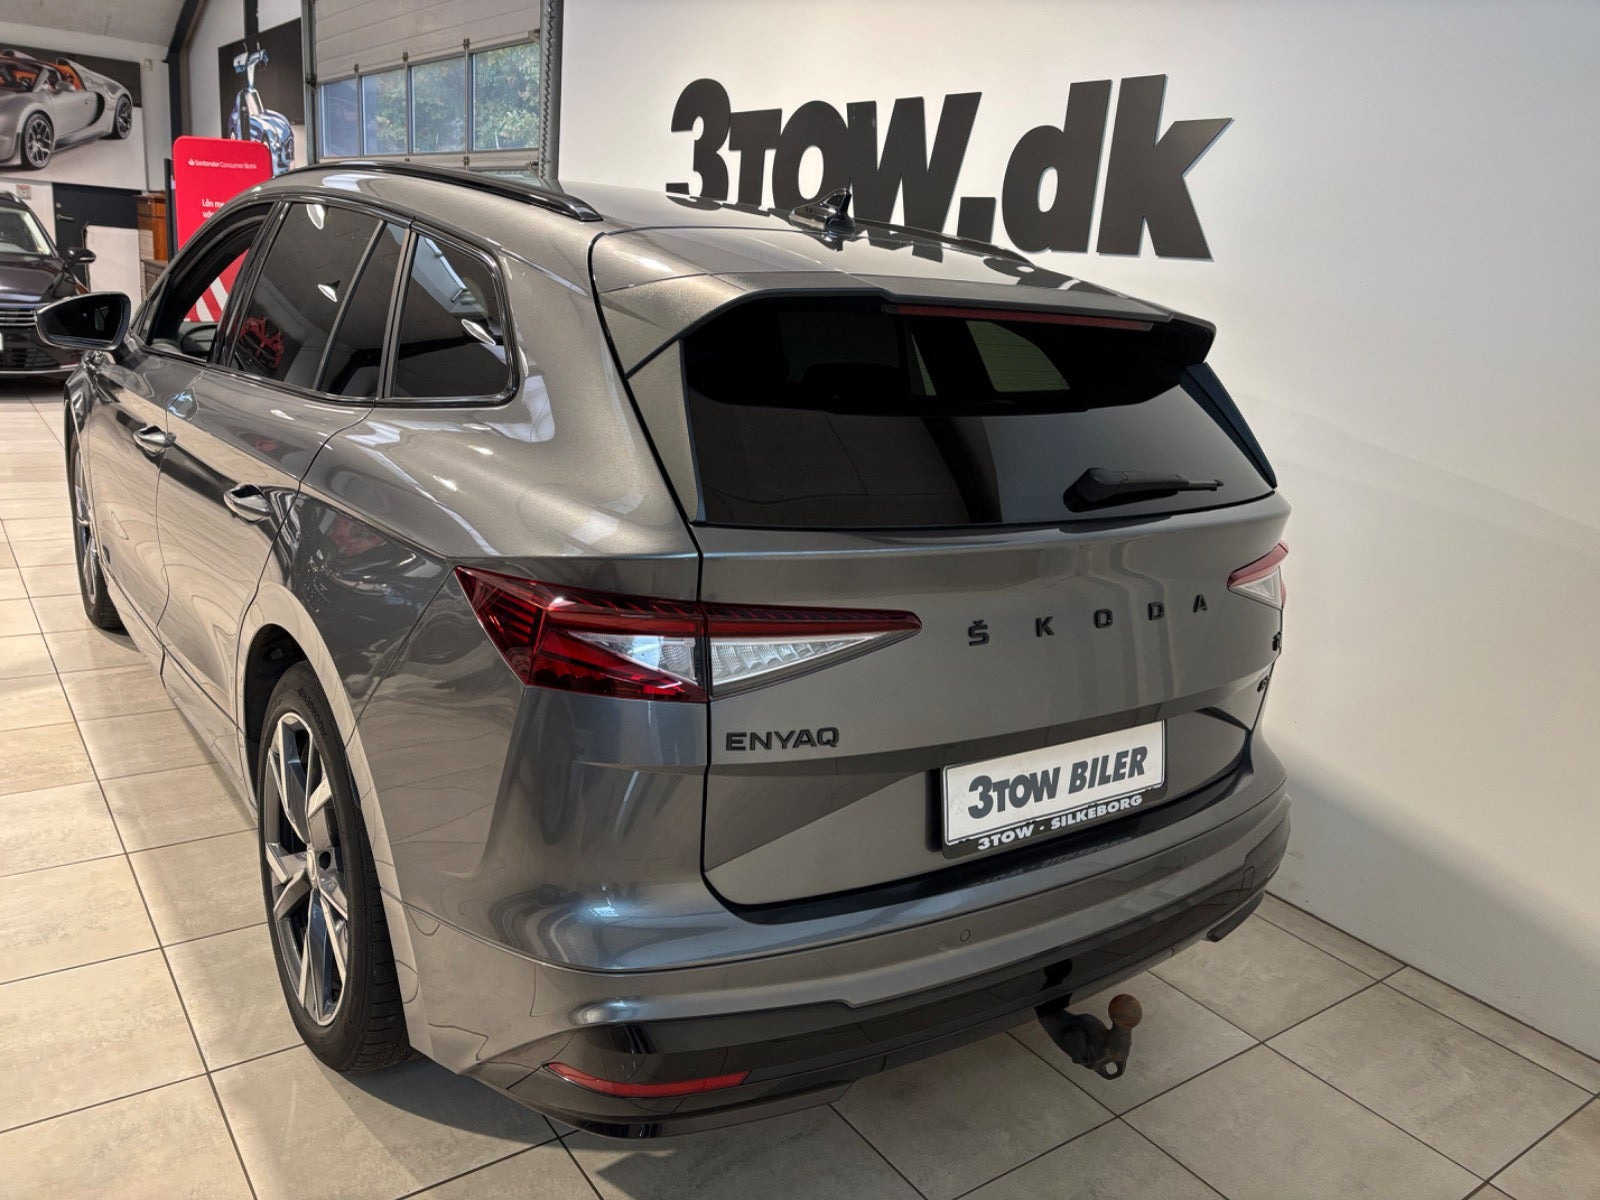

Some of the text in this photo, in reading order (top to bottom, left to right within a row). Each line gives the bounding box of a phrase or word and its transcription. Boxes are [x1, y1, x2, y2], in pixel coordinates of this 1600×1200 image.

[194, 159, 257, 170] Santander Consumer Bank
[666, 74, 1232, 261] 3TOW.dk
[967, 594, 1208, 646] ŠKODA
[725, 726, 840, 751] ENYAQ
[967, 746, 1148, 819] 3TOW BILER
[977, 821, 1035, 850] 3TOW
[1050, 795, 1143, 830] SILKEBORG
